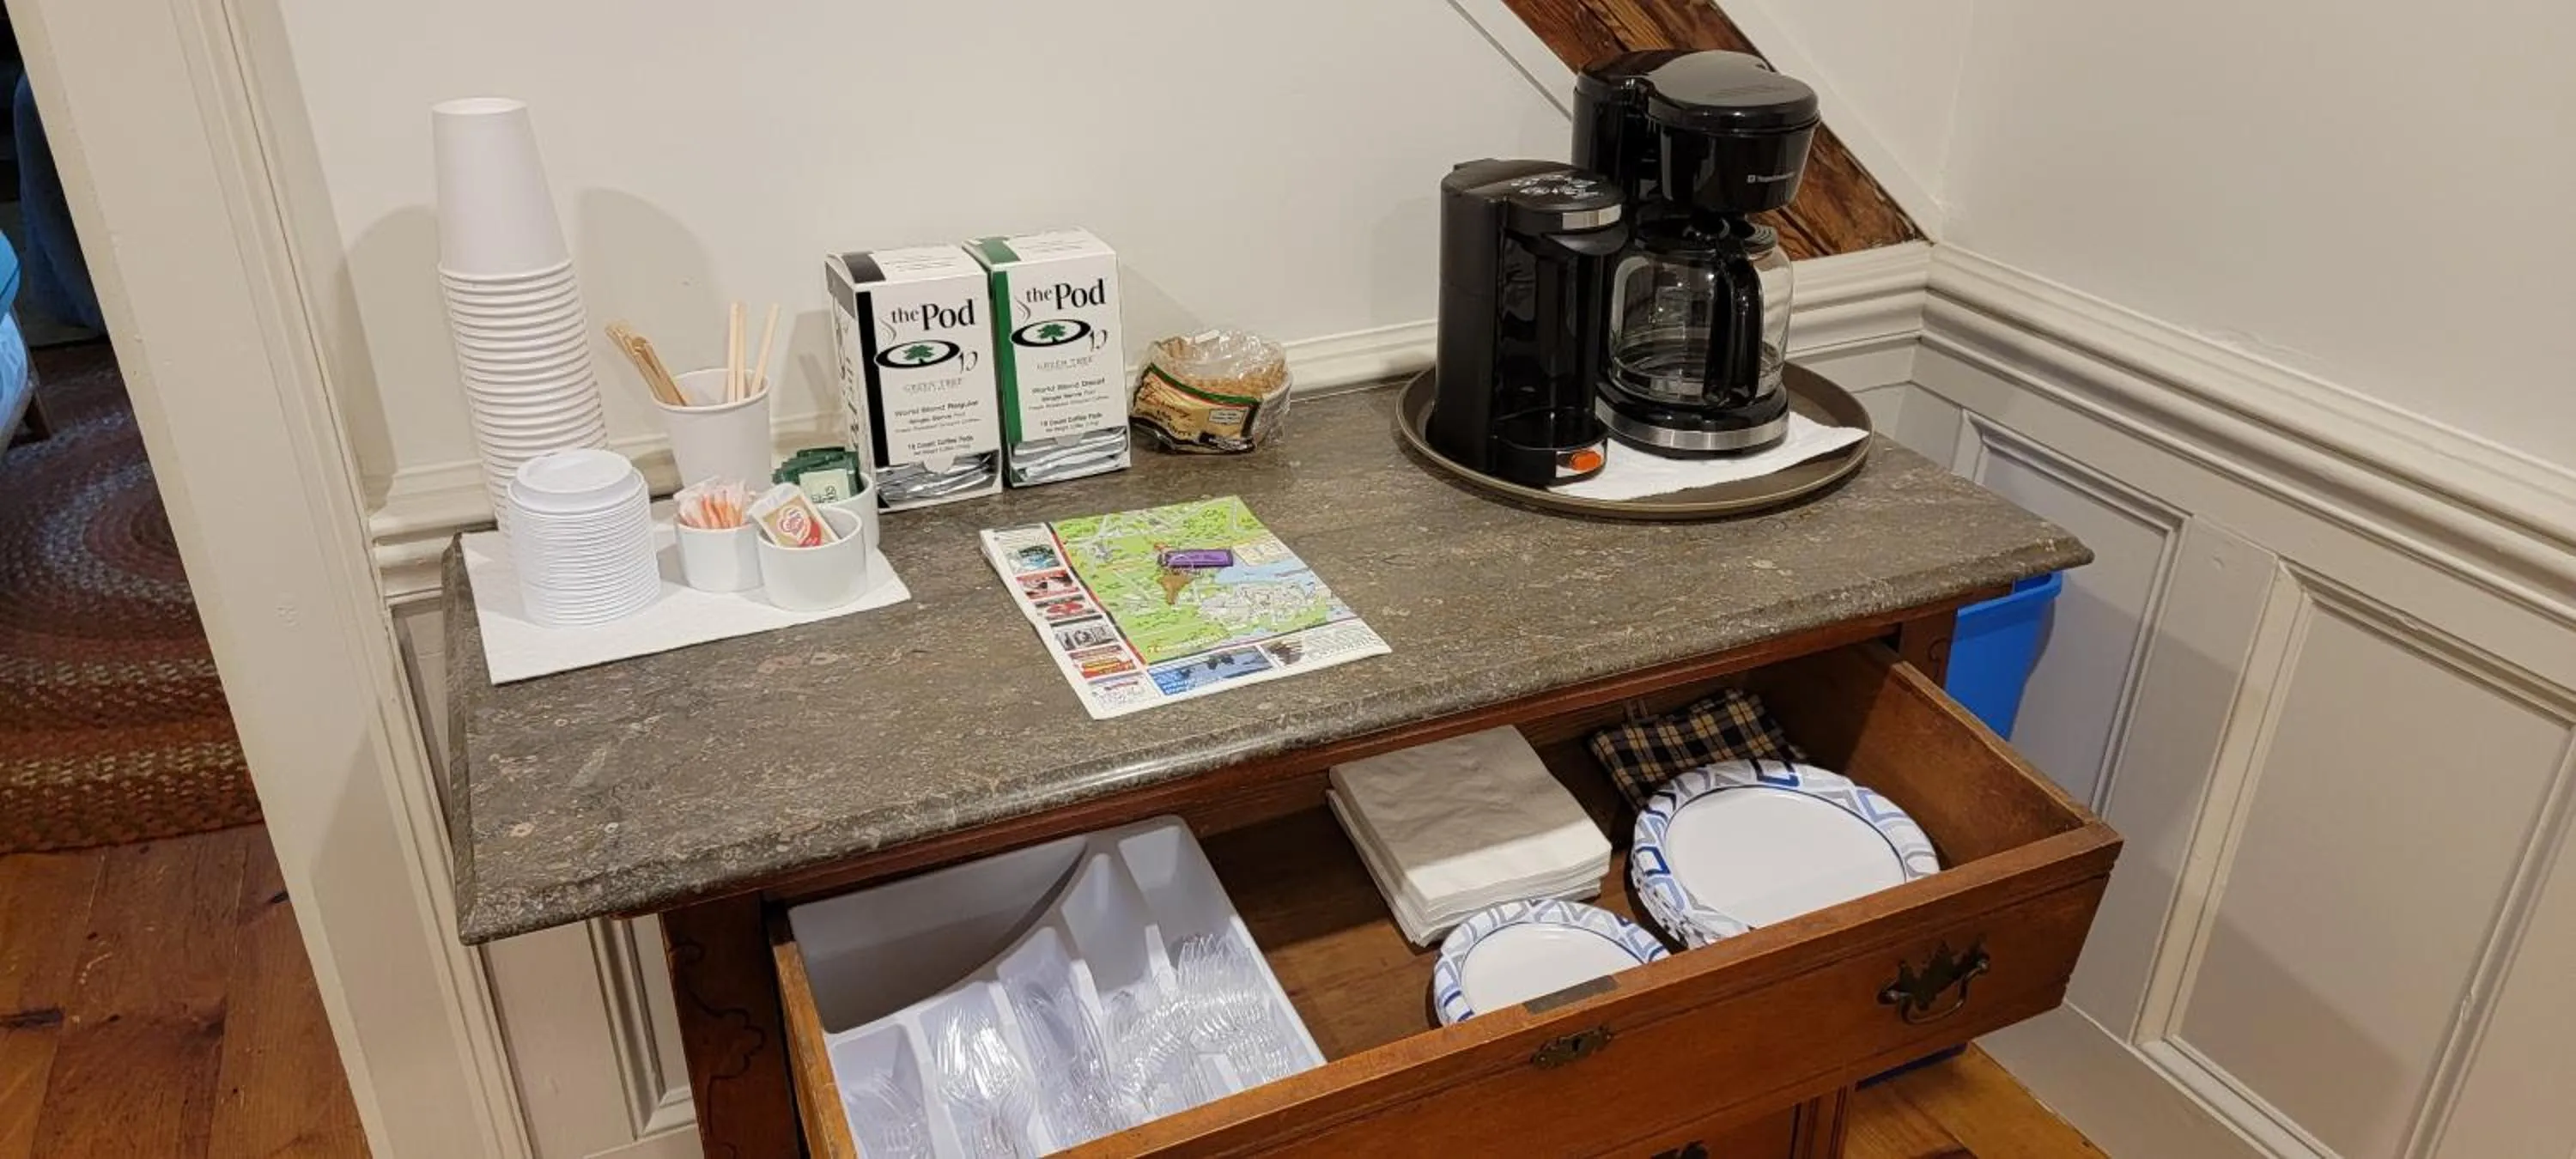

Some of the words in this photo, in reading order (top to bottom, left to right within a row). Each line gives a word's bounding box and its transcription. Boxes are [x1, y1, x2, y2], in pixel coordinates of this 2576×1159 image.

[1026, 288, 1052, 302] the
[1054, 277, 1106, 310] Pod
[891, 306, 919, 324] the
[921, 298, 975, 331] Pod
